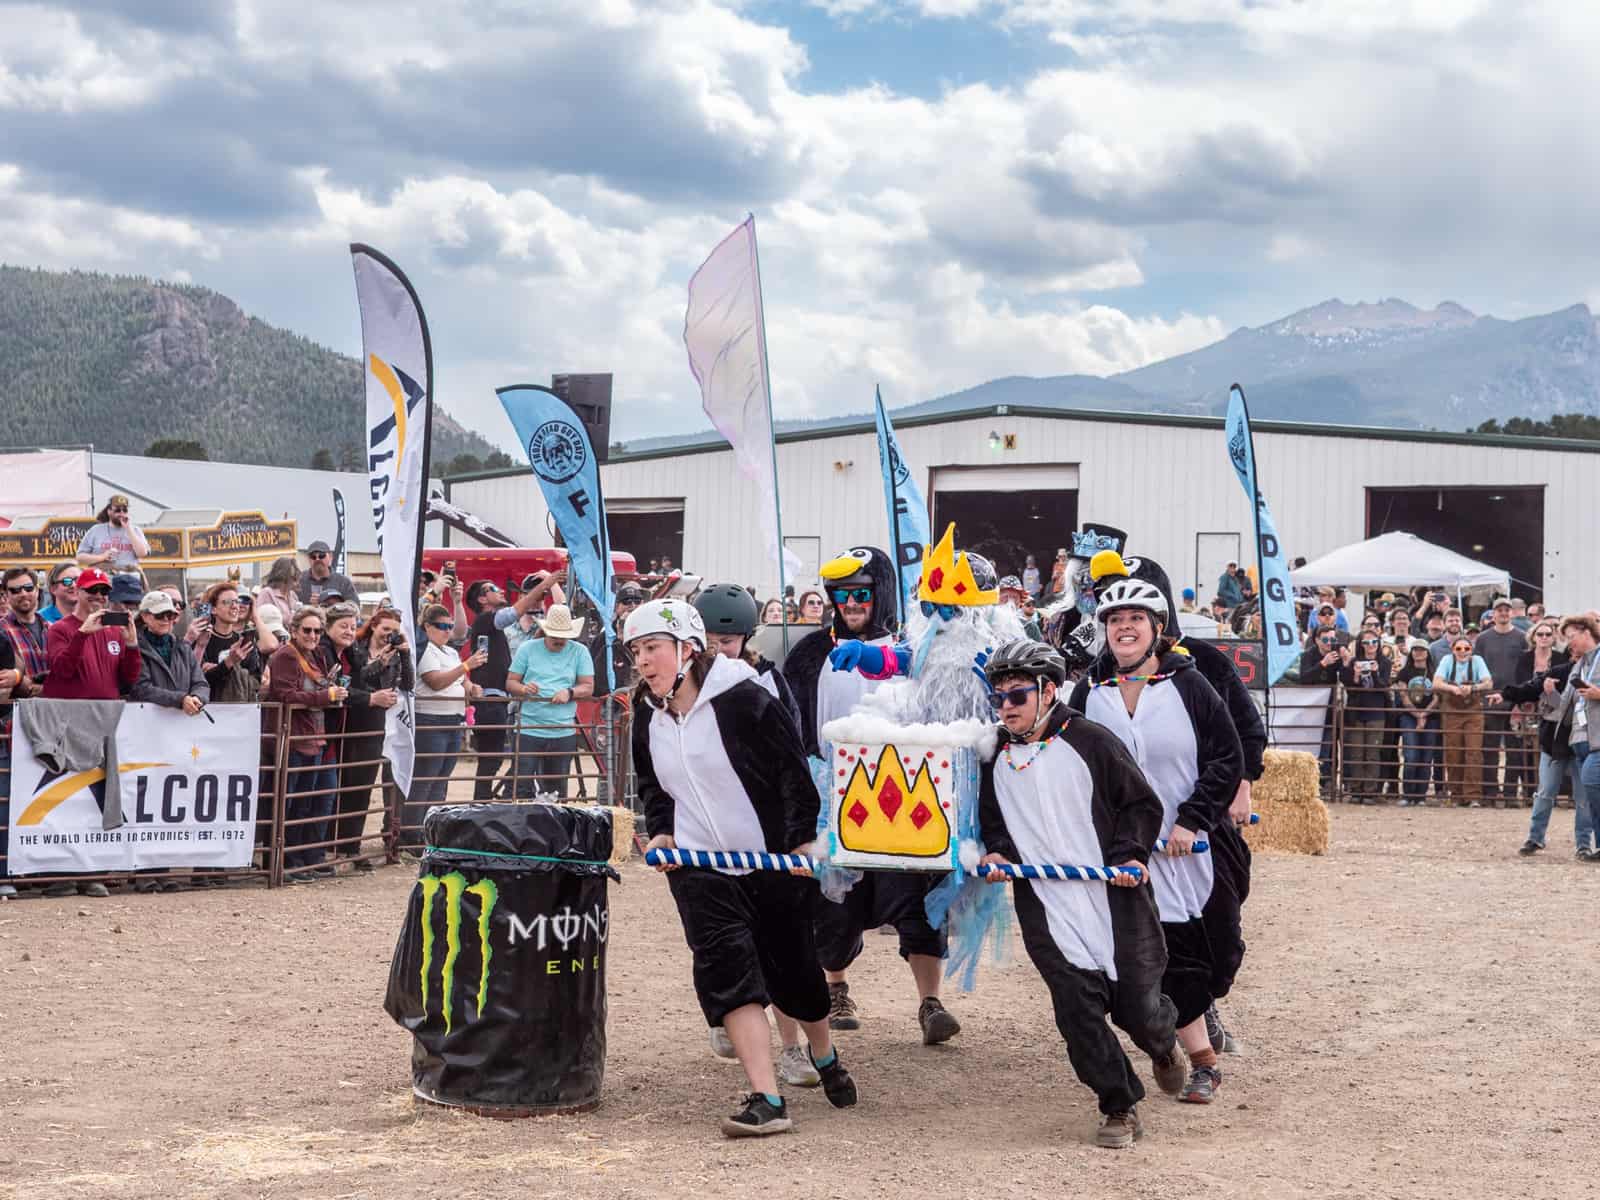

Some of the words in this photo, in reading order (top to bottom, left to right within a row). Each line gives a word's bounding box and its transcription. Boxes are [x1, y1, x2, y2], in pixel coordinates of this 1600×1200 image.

[561, 426, 577, 440] GUY
[208, 530, 279, 551] LEMONADE
[19, 835, 38, 845] THE
[43, 832, 80, 845] WORLD
[85, 831, 122, 843] LEADER
[127, 832, 138, 842] IN
[198, 830, 217, 841] EST.
[222, 830, 246, 841] 1972
